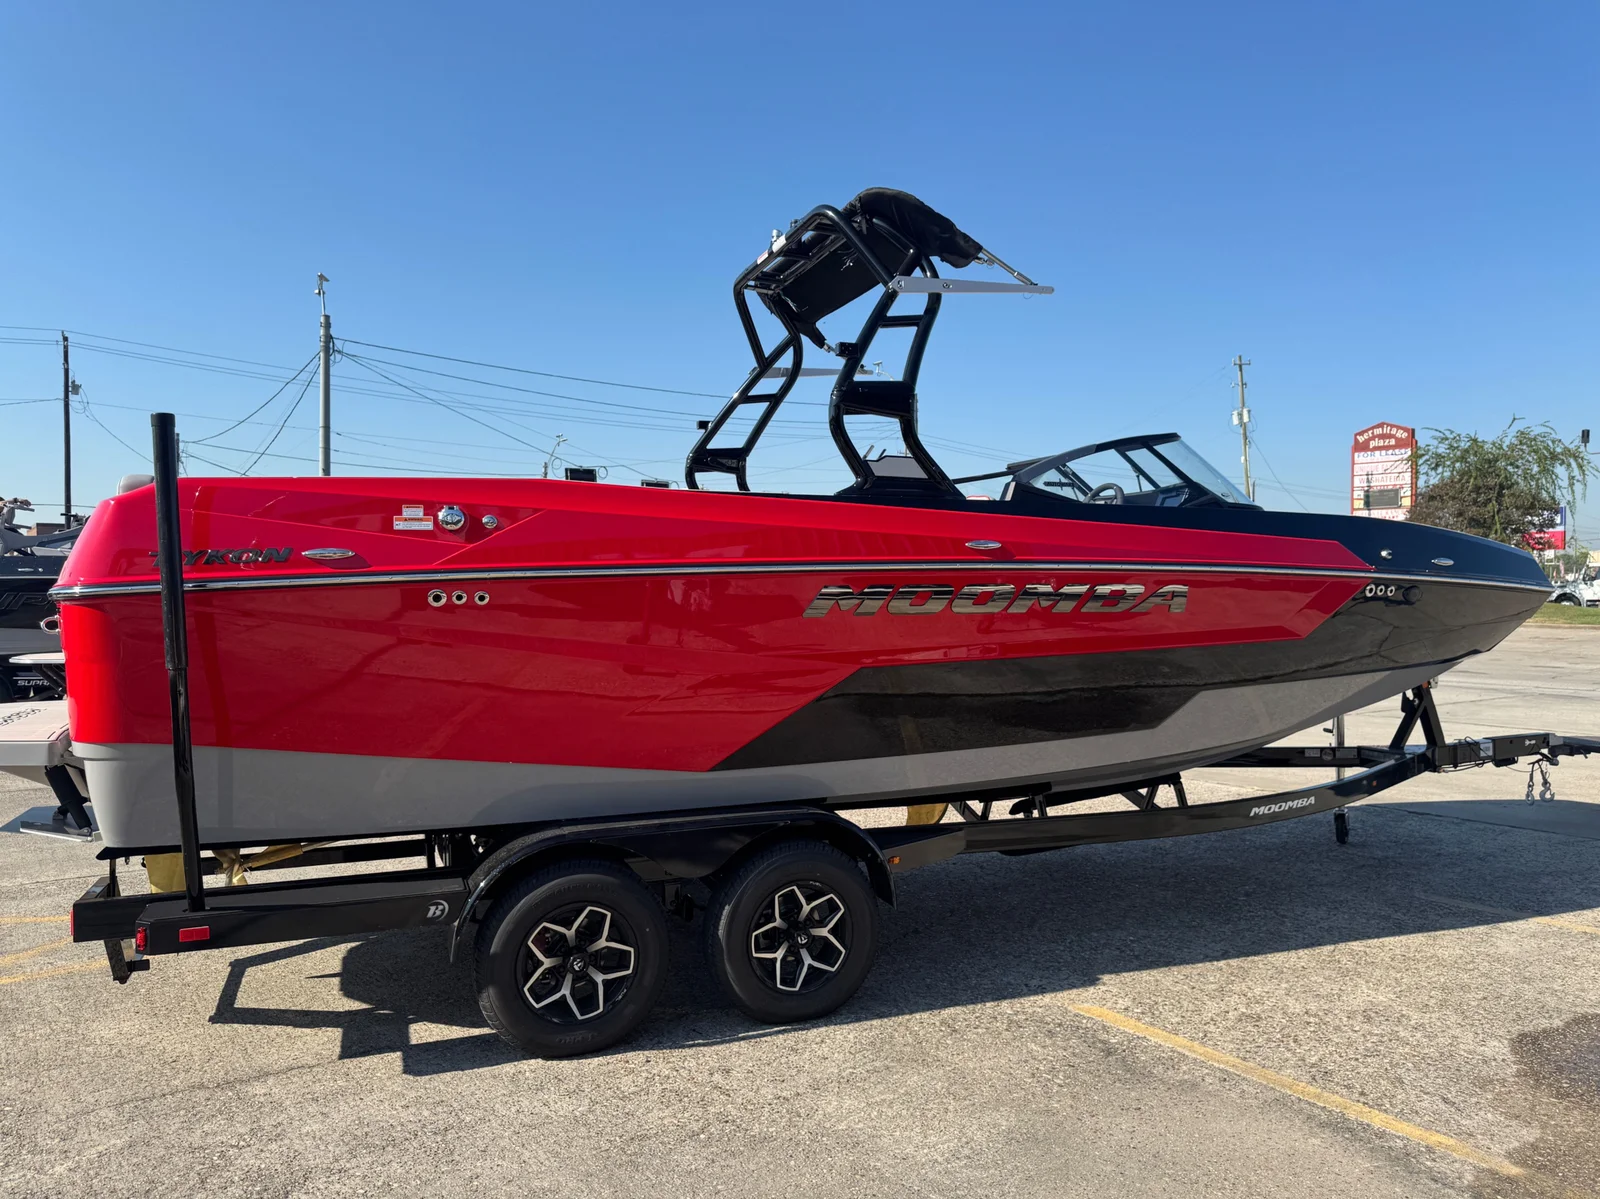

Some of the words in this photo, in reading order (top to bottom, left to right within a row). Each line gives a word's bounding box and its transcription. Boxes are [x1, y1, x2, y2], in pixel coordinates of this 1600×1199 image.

[1356, 424, 1408, 443] hermitage
[1369, 437, 1396, 449] plaza
[1359, 474, 1406, 484] WSHATERIA
[802, 583, 1190, 618] MOOMBA
[1249, 796, 1315, 817] MOOMBA
